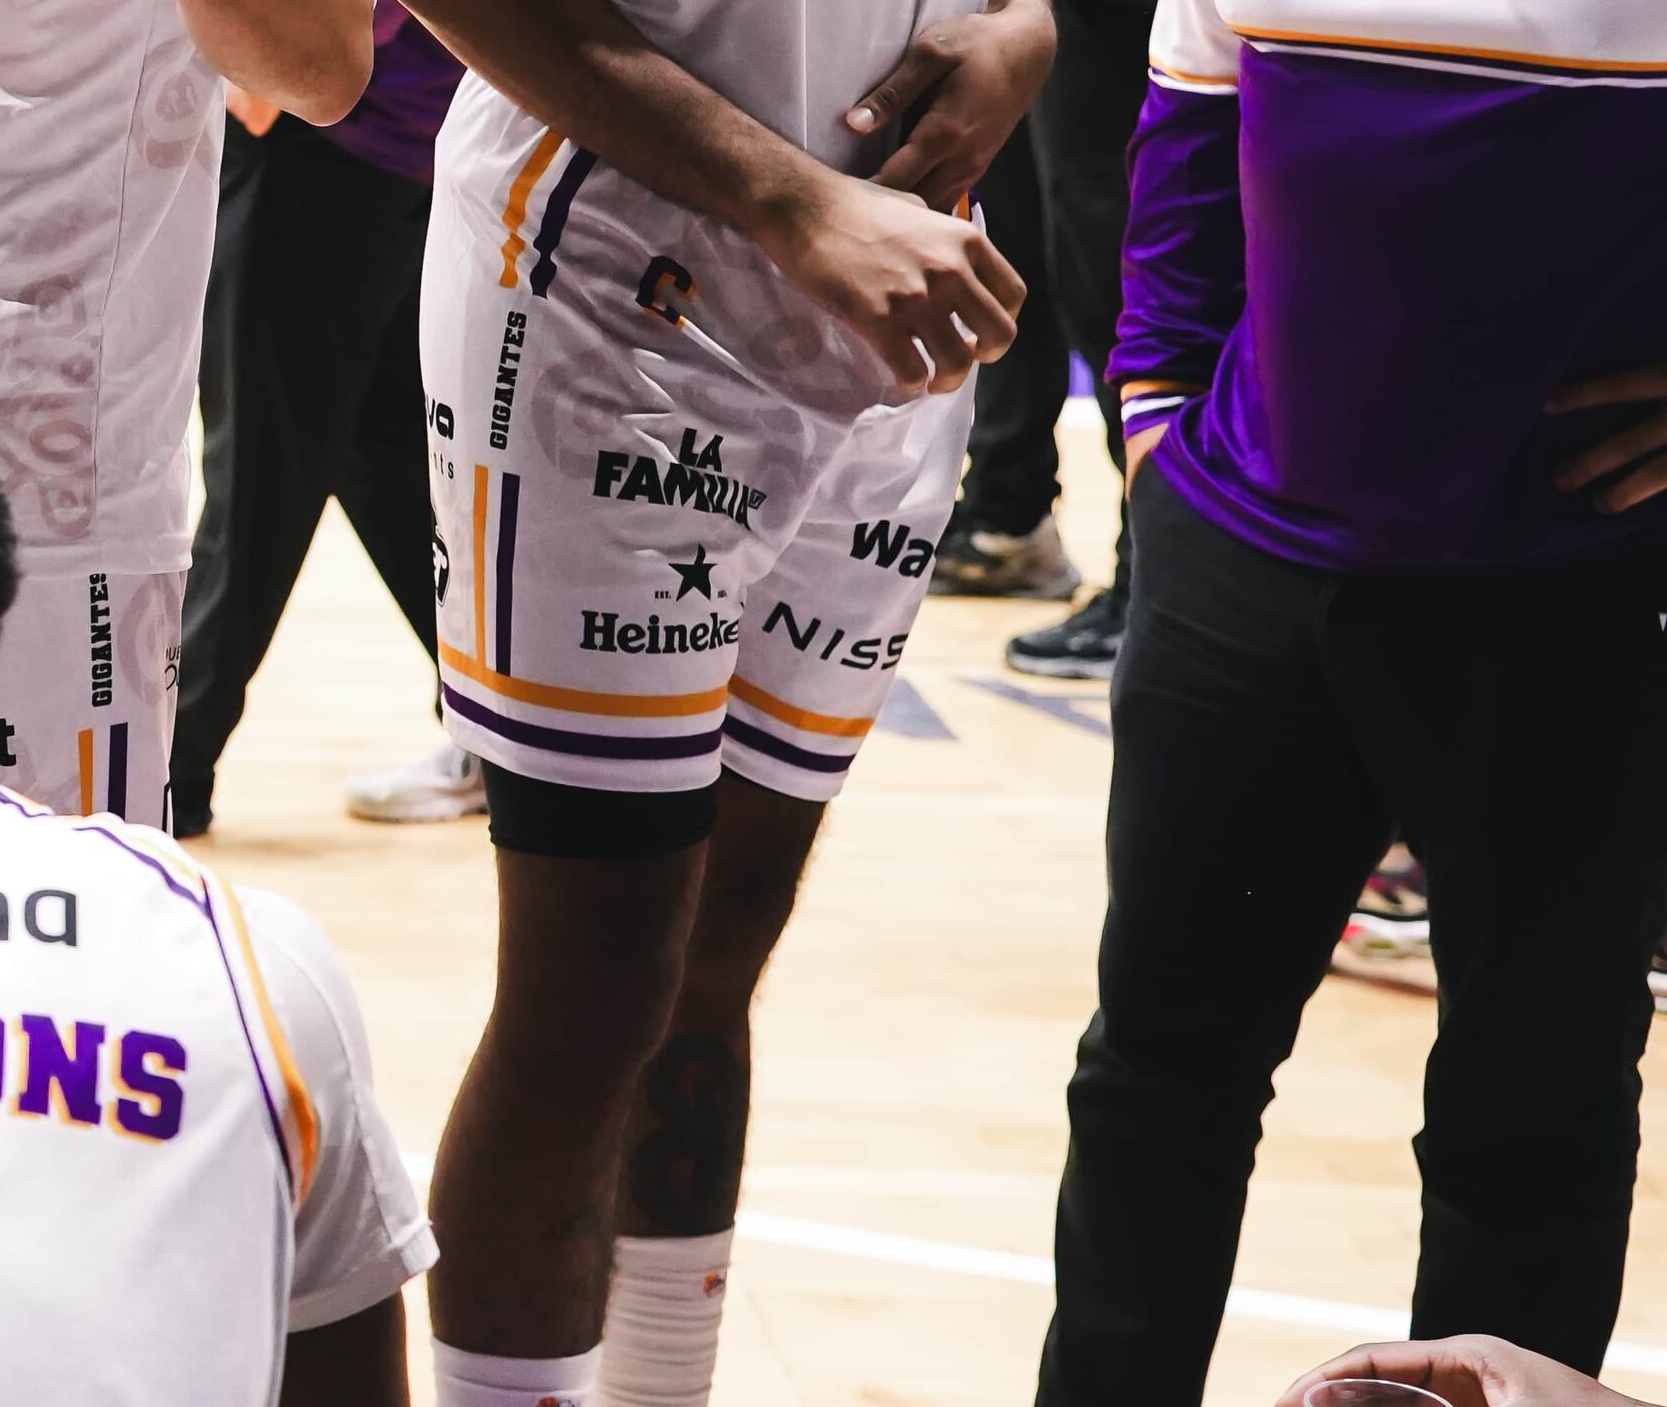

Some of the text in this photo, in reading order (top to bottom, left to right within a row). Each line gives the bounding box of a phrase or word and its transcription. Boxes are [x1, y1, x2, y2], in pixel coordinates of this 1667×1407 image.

[635, 255, 700, 331] C
[489, 309, 529, 452] GIGANTES
[592, 449, 753, 532] FAMILIA
[678, 427, 725, 473] LA
[89, 573, 113, 708] GIGANTES
